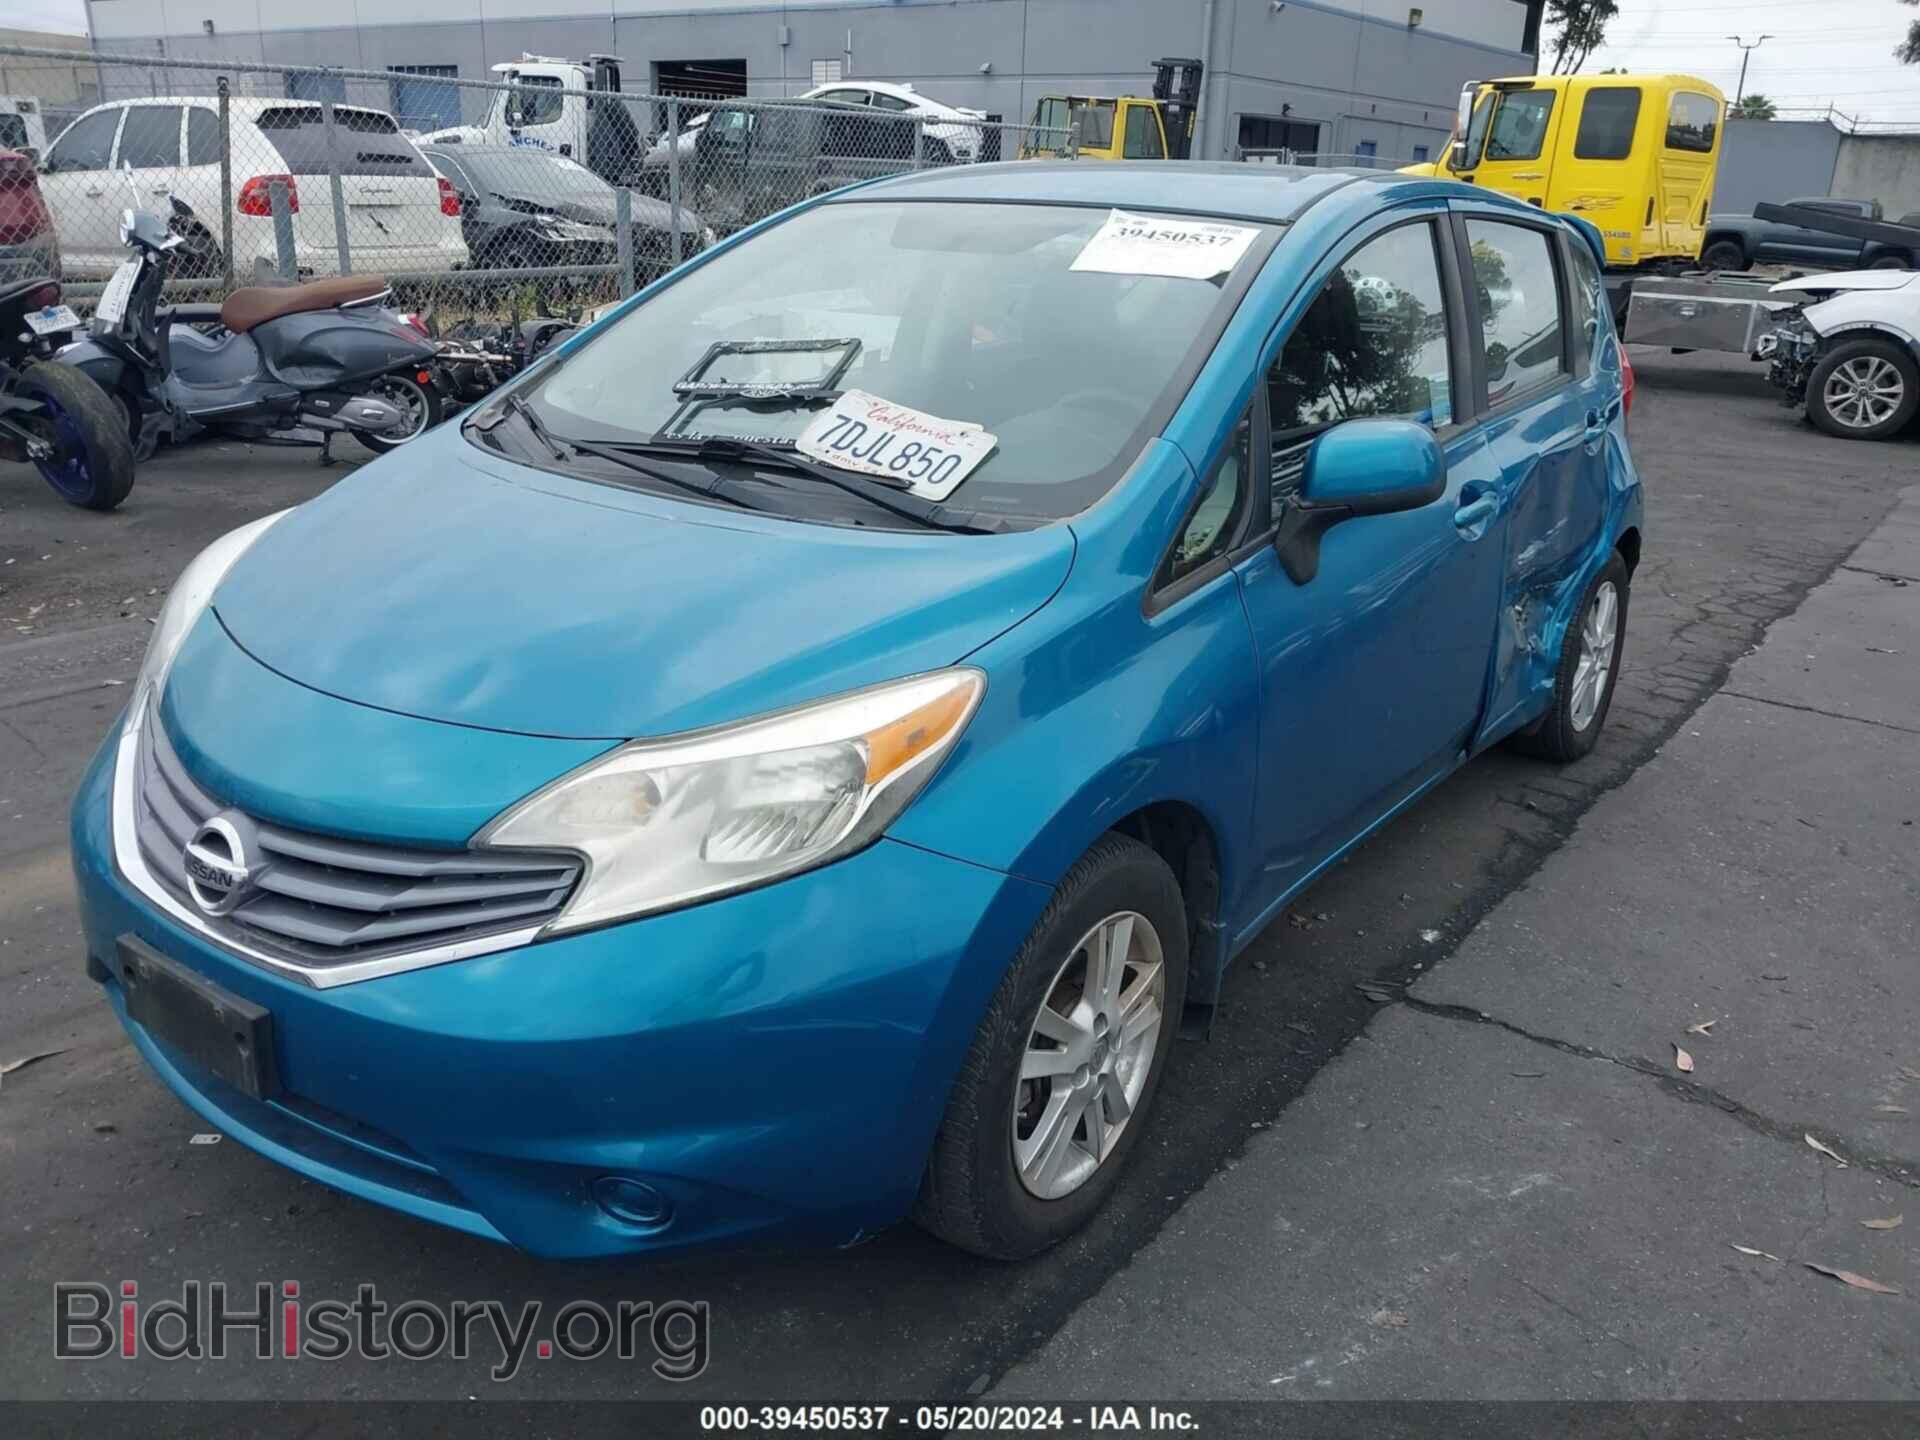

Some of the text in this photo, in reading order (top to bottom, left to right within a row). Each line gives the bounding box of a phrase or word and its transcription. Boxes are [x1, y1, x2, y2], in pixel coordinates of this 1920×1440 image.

[1111, 227, 1234, 247] 39450537
[866, 405, 957, 446] California
[816, 414, 962, 485] 7DJL850
[190, 861, 233, 888] SSAN
